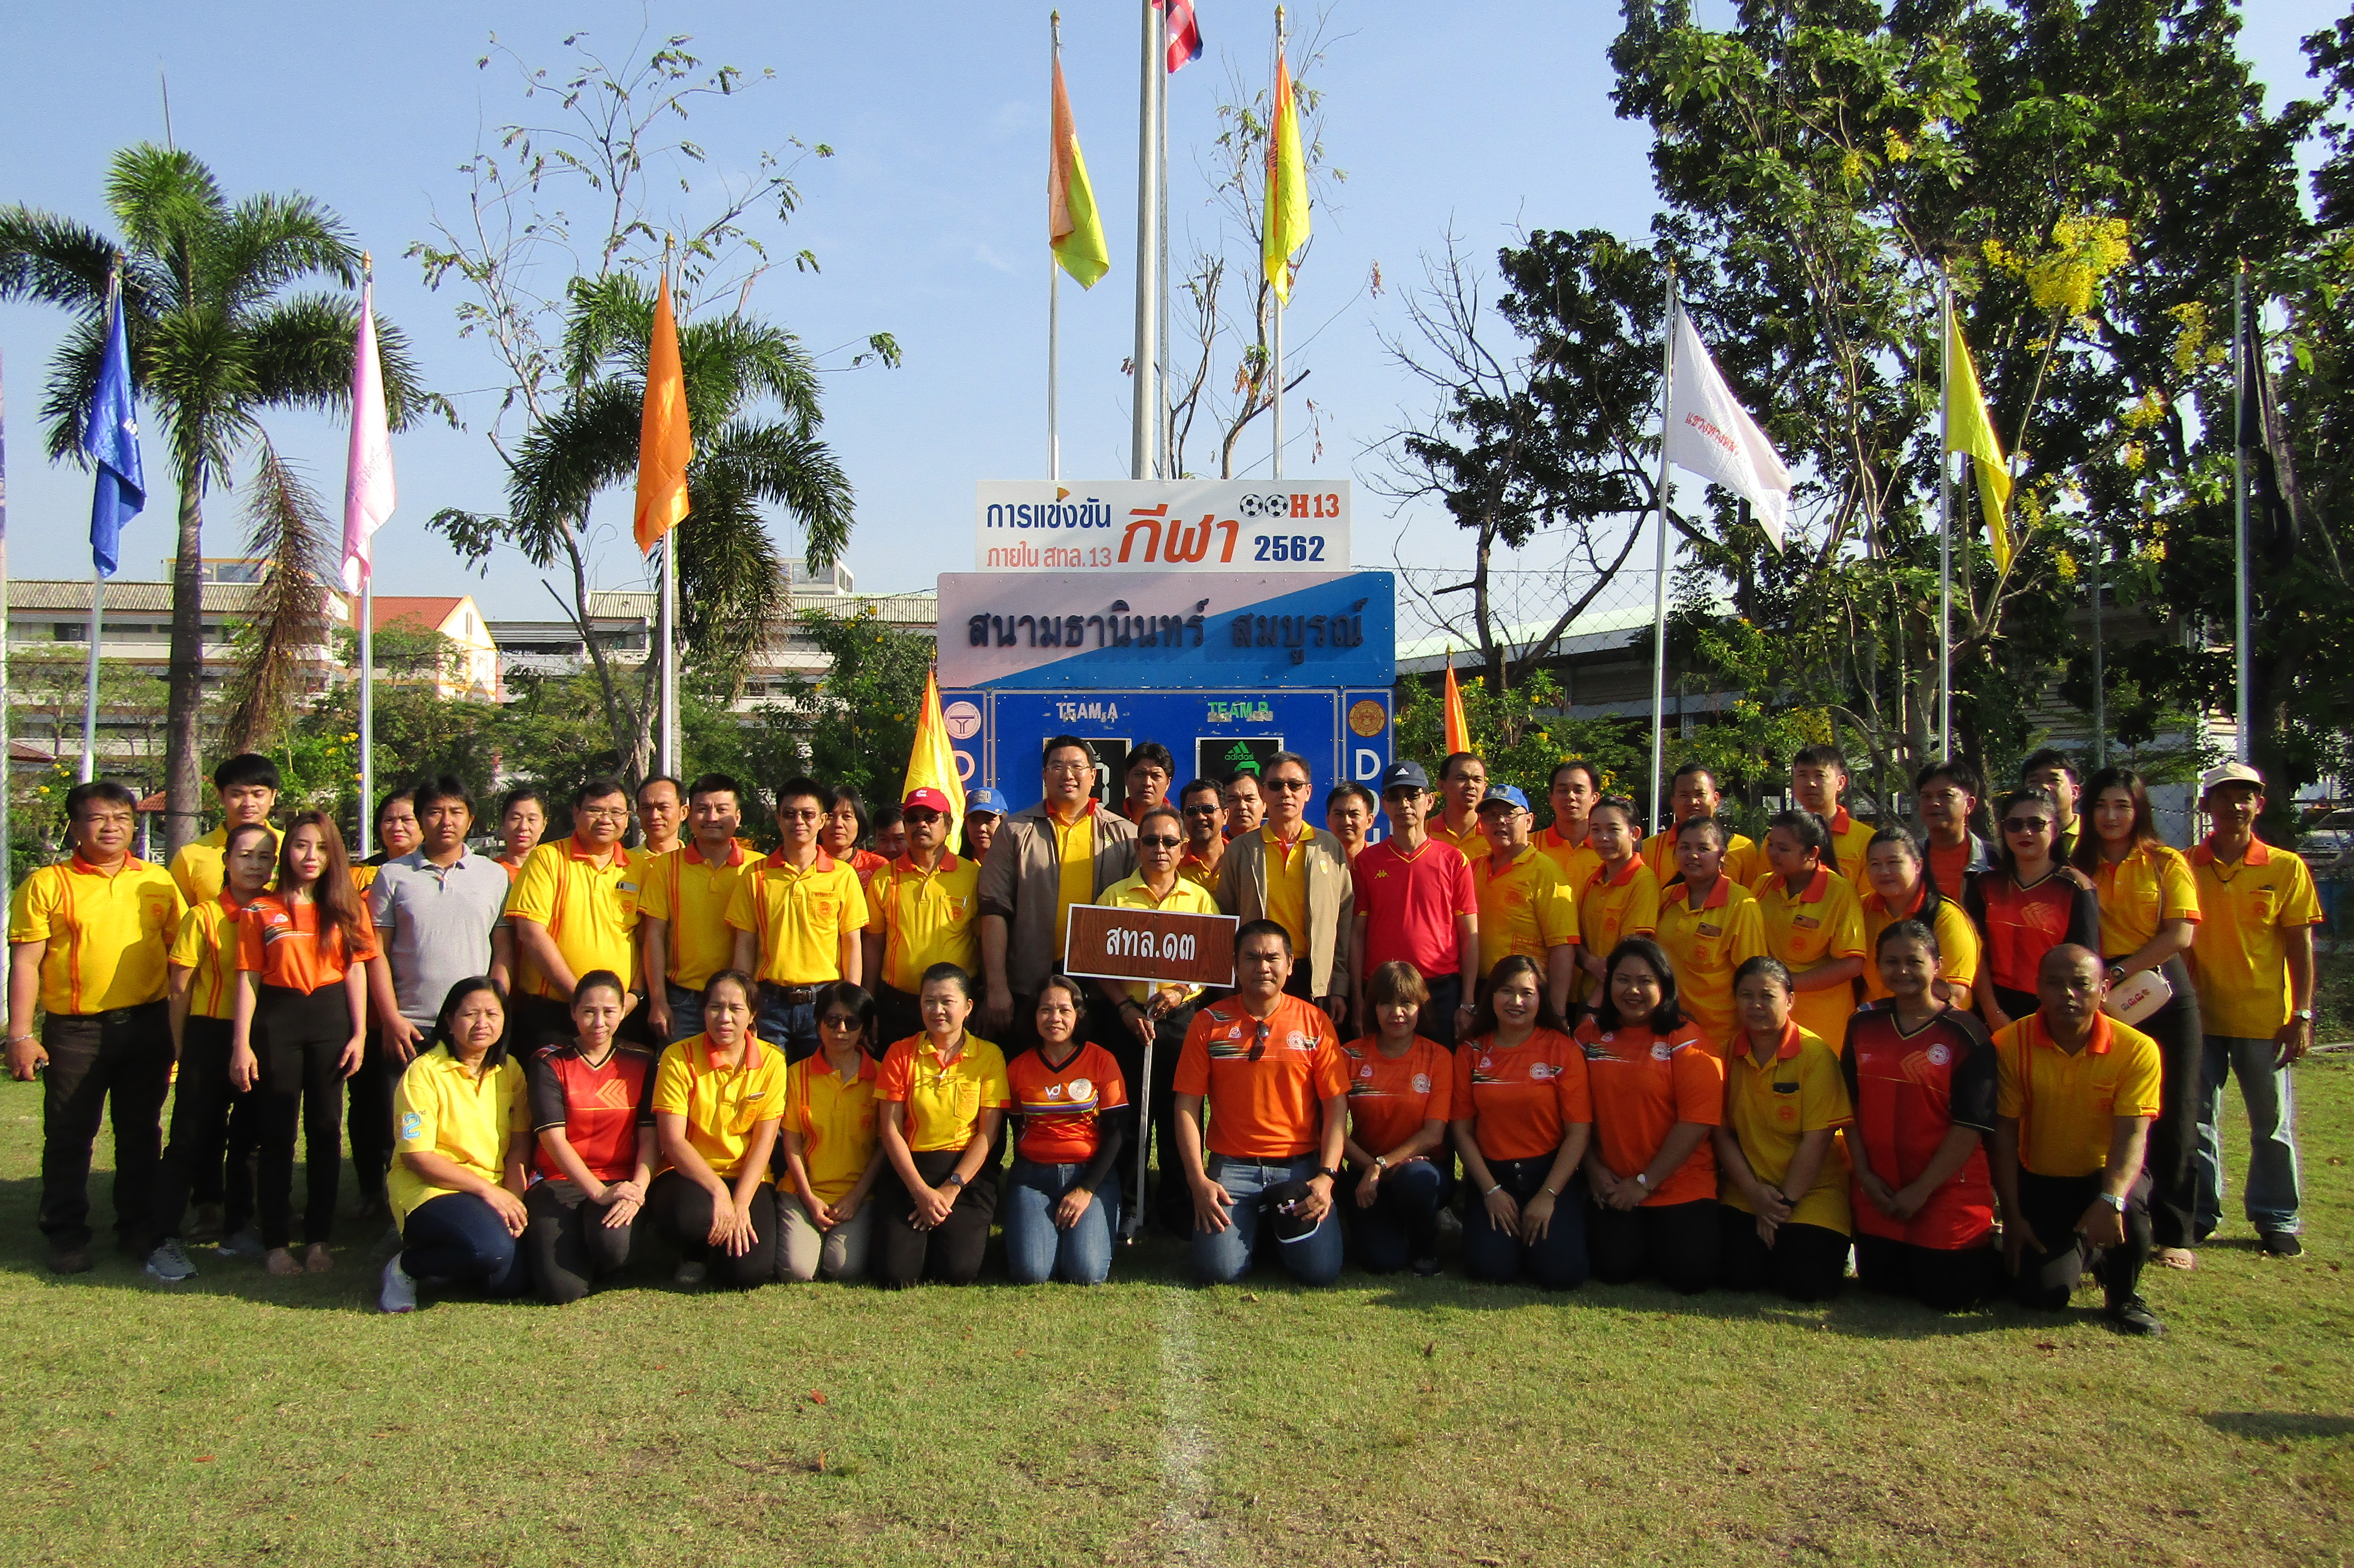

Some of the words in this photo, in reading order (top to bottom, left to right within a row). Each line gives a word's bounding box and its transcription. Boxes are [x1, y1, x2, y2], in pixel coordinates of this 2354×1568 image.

[1118, 503, 1240, 563] กีฬา
[987, 541, 1039, 567] ภายใน
[1254, 535, 1325, 562] 2562
[969, 598, 1209, 647] สนามธานินทร์
[1232, 598, 1368, 665] สมบูรณ์
[1056, 702, 1101, 719] TEAM
[1107, 702, 1119, 719] A
[1208, 701, 1253, 718] TEAM
[1106, 927, 1195, 961] สทล.๑๓
